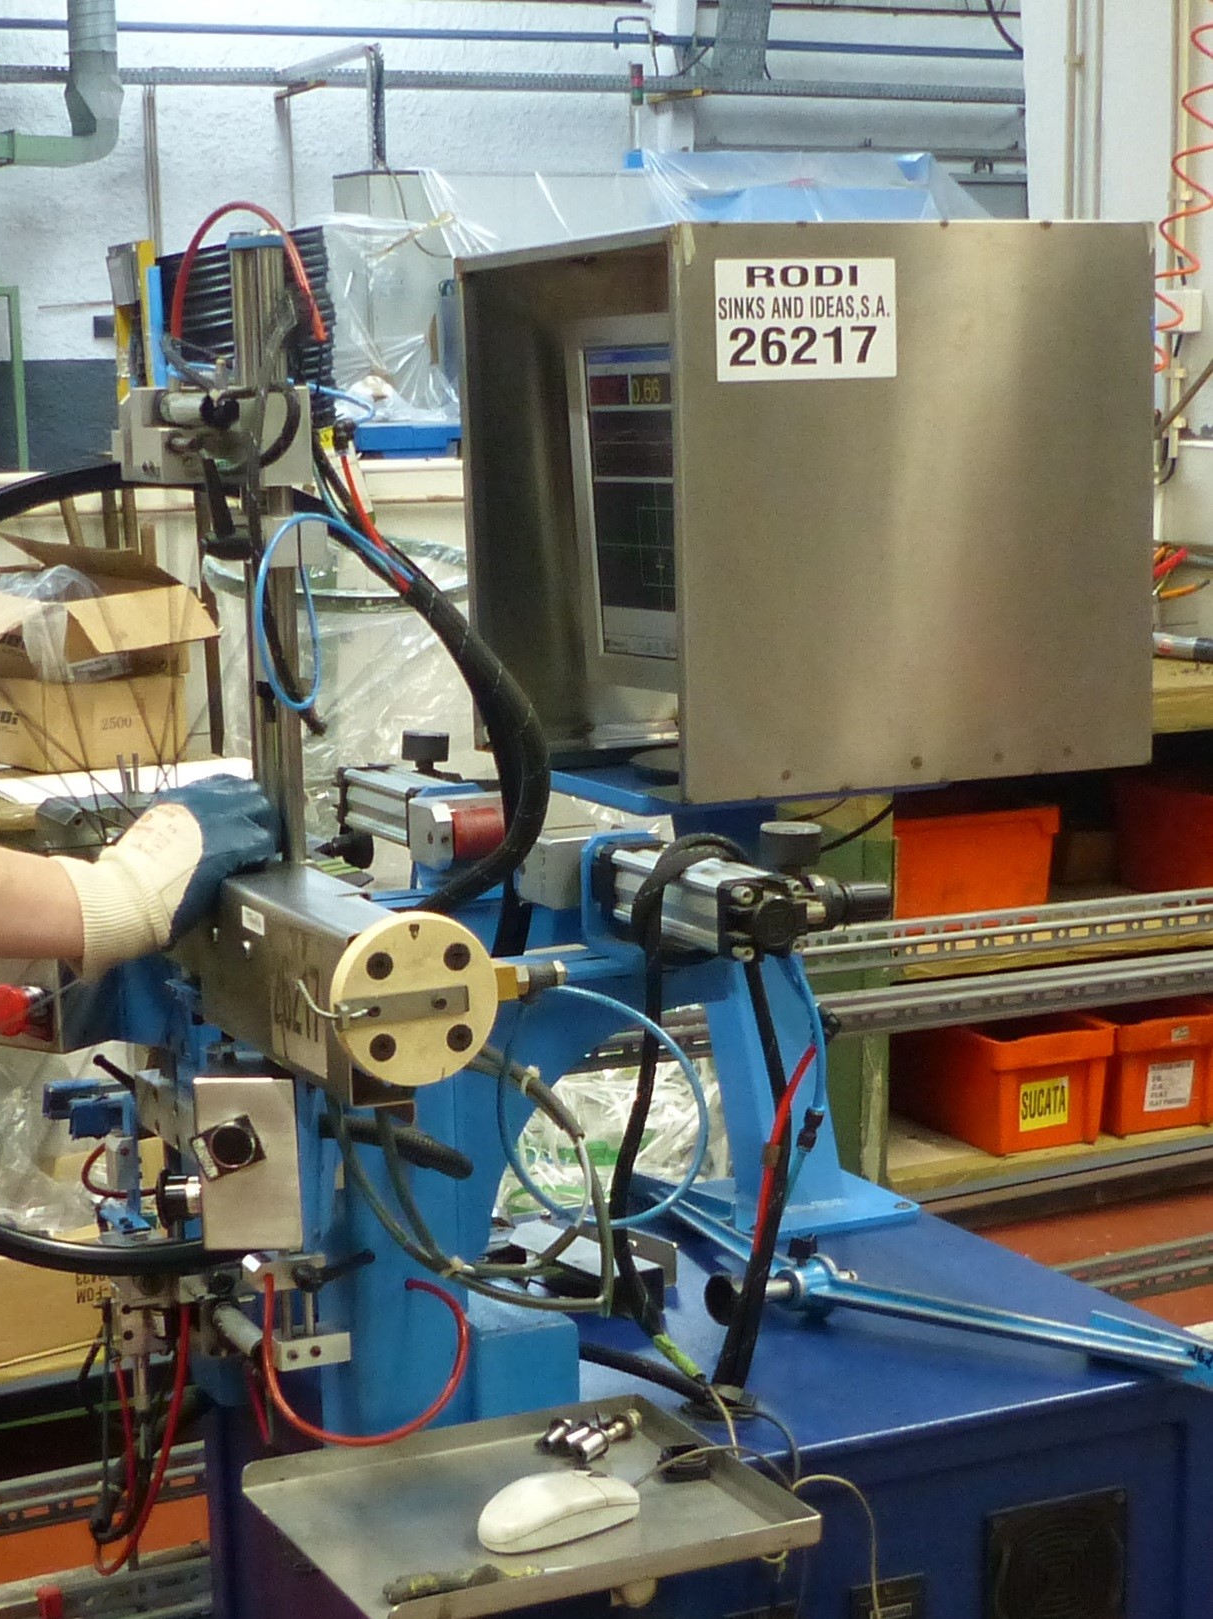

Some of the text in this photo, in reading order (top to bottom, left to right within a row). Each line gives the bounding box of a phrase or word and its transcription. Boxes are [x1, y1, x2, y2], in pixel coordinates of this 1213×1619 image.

[746, 265, 858, 288] RODI
[718, 297, 765, 320] SINKS
[771, 297, 804, 319] AND
[729, 325, 877, 366] 26217
[1022, 1084, 1066, 1120] SUCATA
